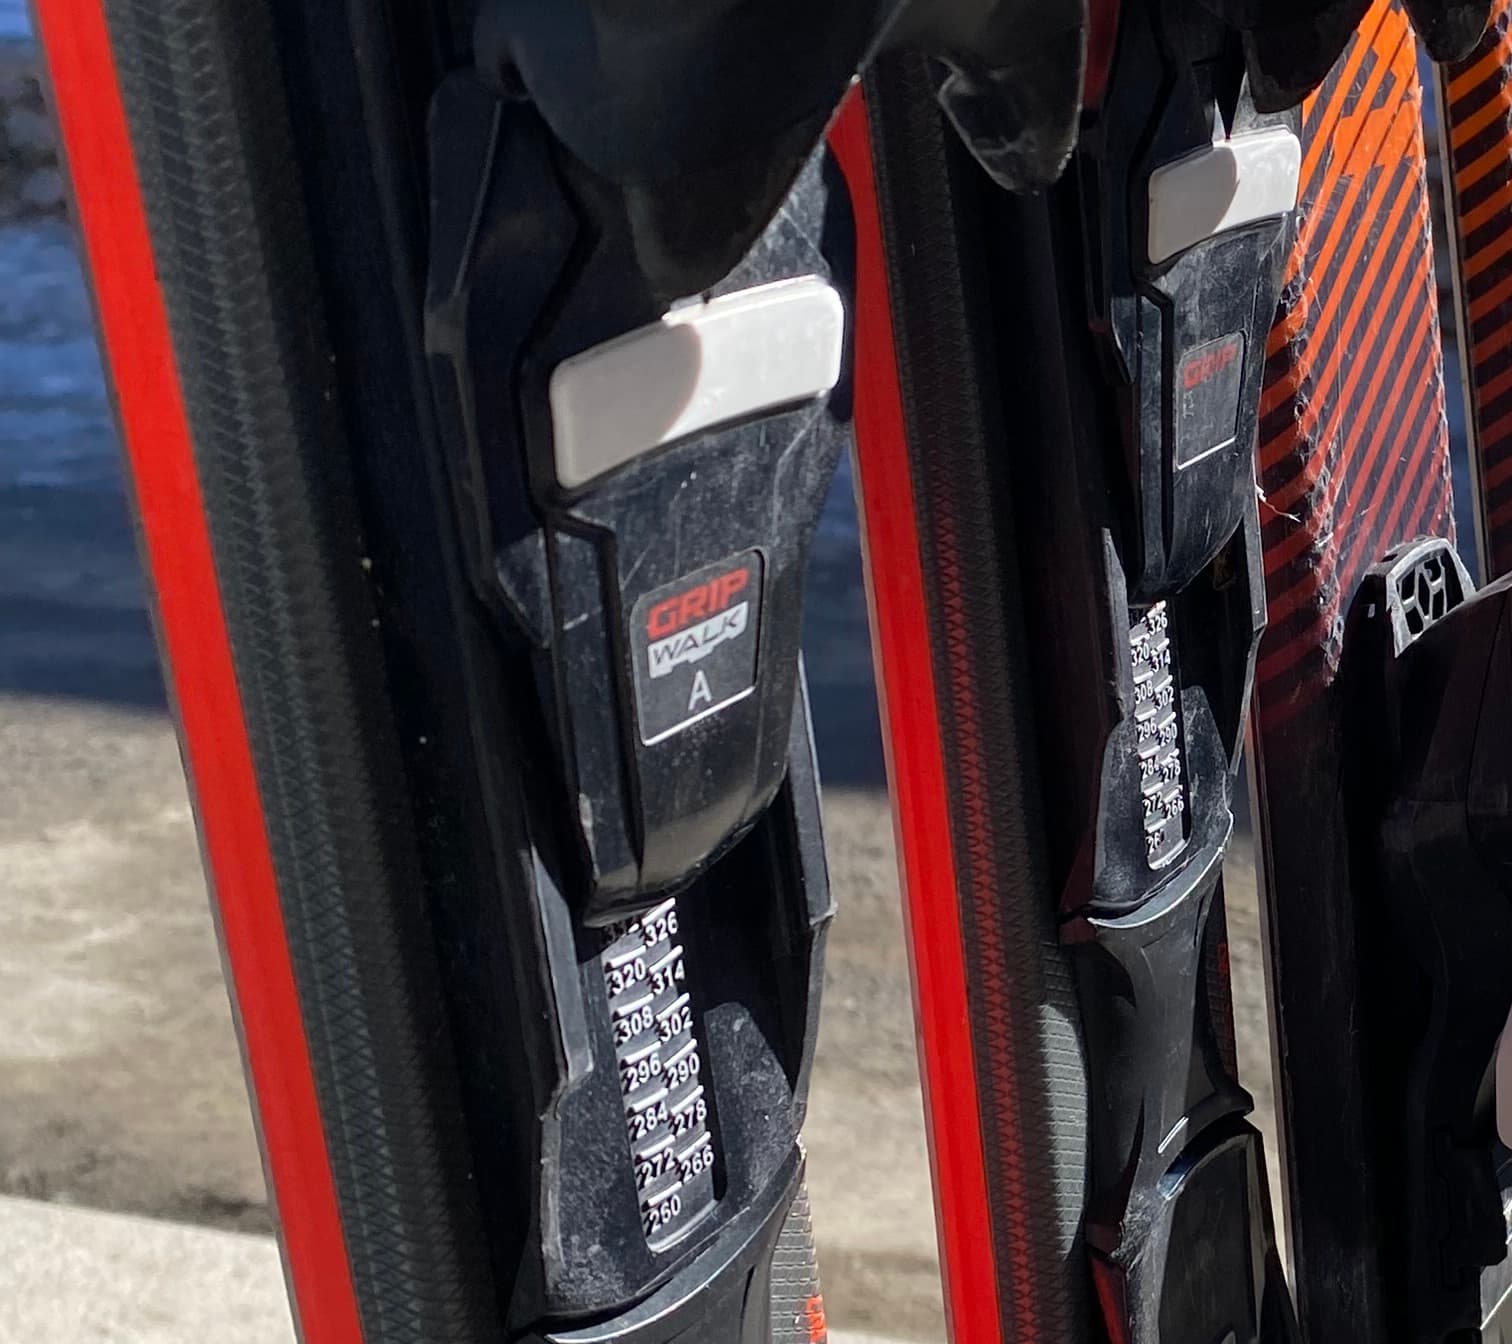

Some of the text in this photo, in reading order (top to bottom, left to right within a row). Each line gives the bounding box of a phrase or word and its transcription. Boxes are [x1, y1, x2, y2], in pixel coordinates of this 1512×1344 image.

[647, 568, 750, 641] GRIP
[654, 607, 740, 665] WALK
[1150, 615, 1168, 636] 326
[1132, 644, 1149, 667] 320
[1152, 649, 1171, 673] 314
[687, 669, 712, 711] A
[1134, 680, 1153, 705] 308
[1156, 685, 1174, 711] 302
[1138, 718, 1156, 743] 296
[1160, 722, 1178, 747] 290
[1163, 758, 1181, 784] 278
[1144, 792, 1163, 816] 272
[645, 911, 679, 947] 326
[612, 959, 646, 994] 320
[652, 959, 685, 995] 314
[619, 1006, 654, 1043] 308
[660, 1006, 693, 1042] 302
[626, 1053, 662, 1091] 296
[667, 1052, 700, 1090] 290
[634, 1102, 669, 1139] 284
[674, 1098, 707, 1136] 278
[641, 1146, 675, 1185] 272
[681, 1144, 714, 1182] 266
[649, 1193, 681, 1232] 260
